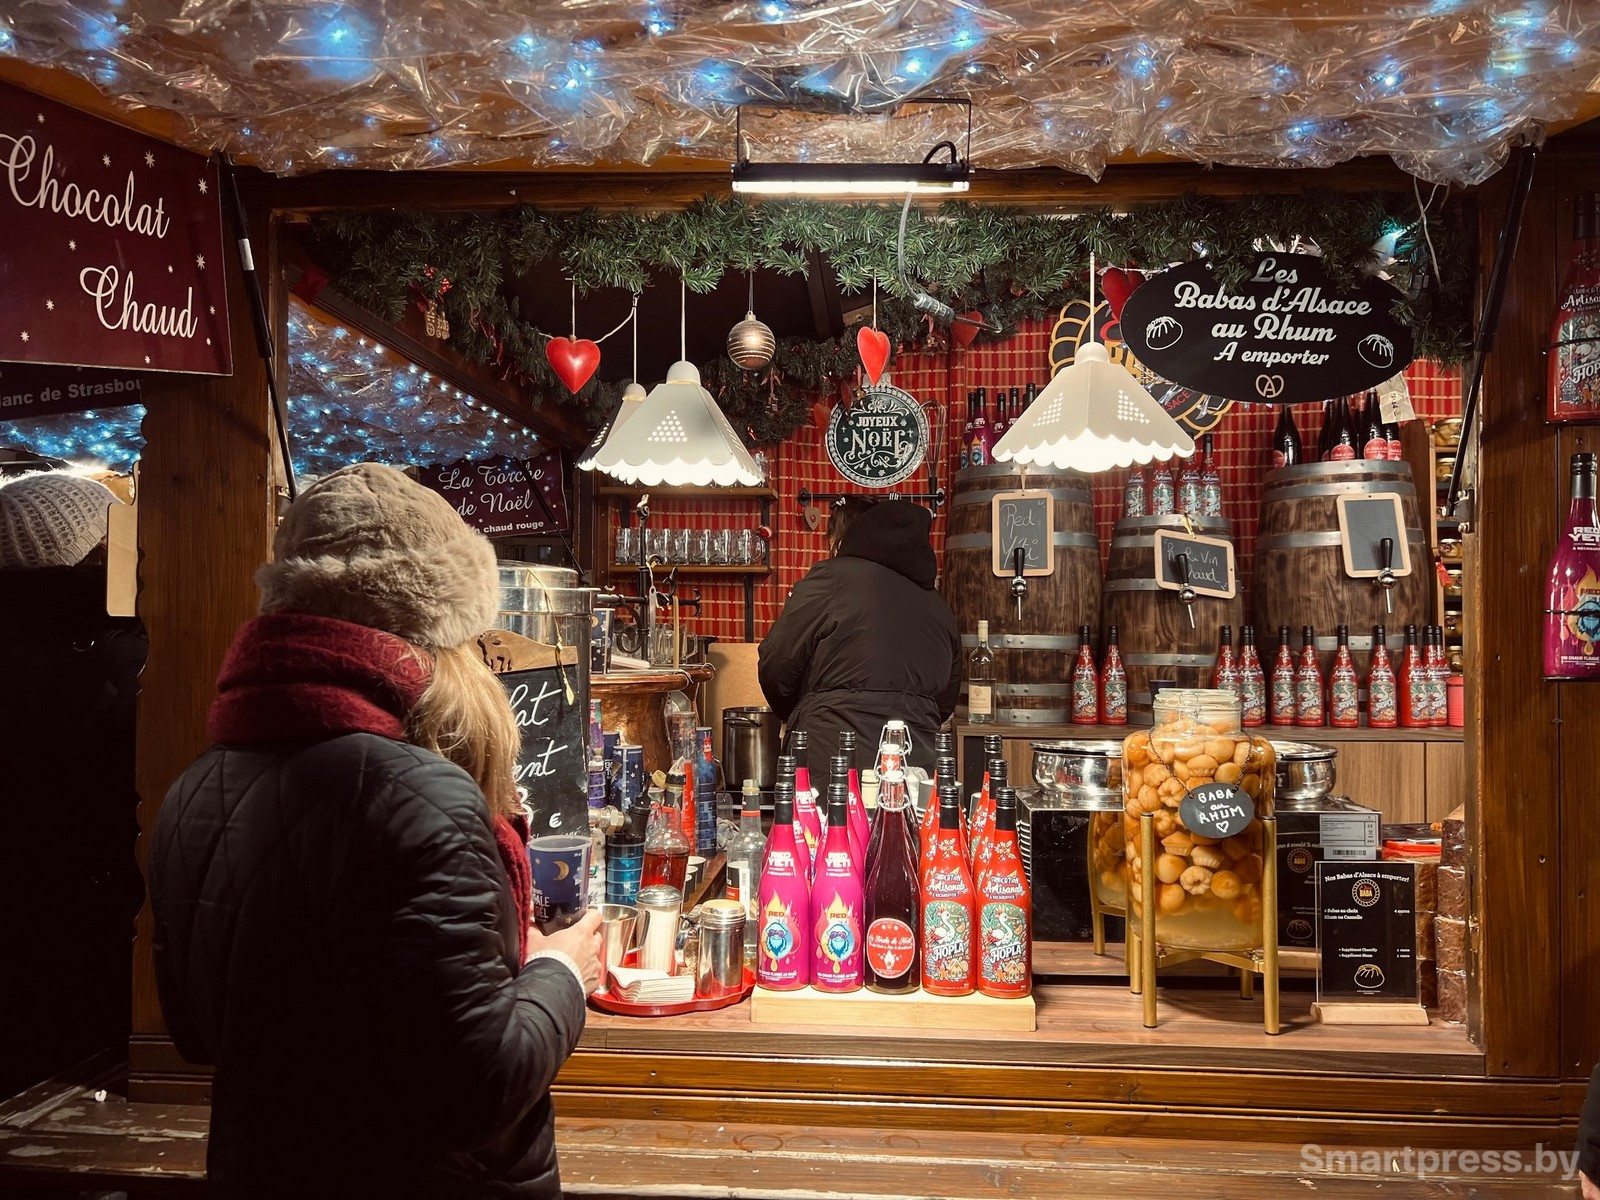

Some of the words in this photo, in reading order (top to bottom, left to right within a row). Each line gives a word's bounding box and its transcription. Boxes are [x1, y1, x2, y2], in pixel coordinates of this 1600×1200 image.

[0, 135, 170, 239] Chocolat
[1250, 256, 1298, 284] Les
[79, 265, 198, 339] Chaud
[1174, 280, 1256, 310] Babas
[1211, 321, 1247, 338] au
[1253, 312, 1337, 343] Rhum
[1213, 341, 1239, 361] A
[1240, 348, 1330, 368] emporter
[40, 387, 61, 402] de
[855, 416, 899, 428] JOYEUX
[438, 468, 474, 490] La
[457, 497, 477, 516] de
[480, 489, 534, 513] Noël
[483, 522, 513, 533] chaud
[516, 520, 544, 531] rouge
[1000, 503, 1036, 540] Red
[1200, 550, 1218, 566] Vin
[1187, 564, 1221, 584] haud
[1197, 788, 1235, 804] BABA
[1210, 803, 1230, 811] au
[548, 812, 562, 829] €
[1198, 805, 1246, 824] RHUM
[931, 940, 965, 962] HOPLA
[988, 942, 1023, 964] HOPLA
